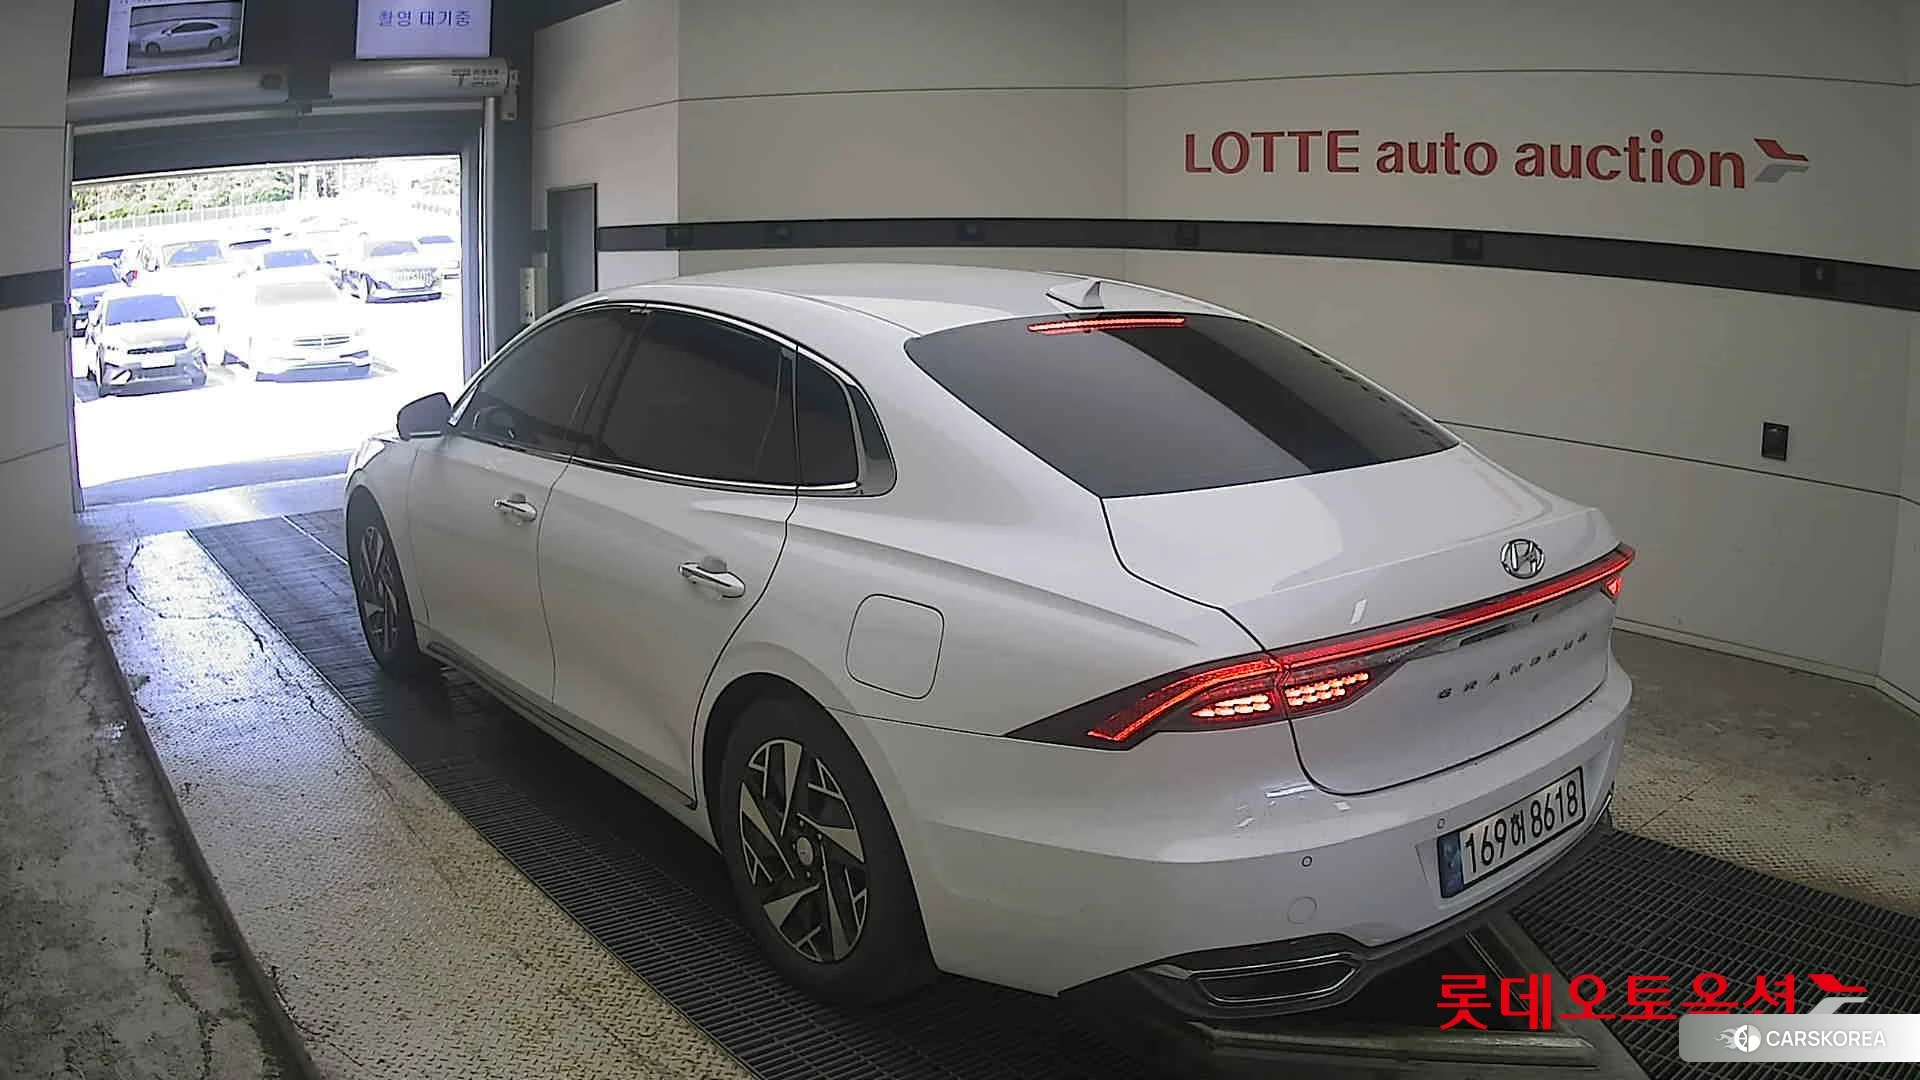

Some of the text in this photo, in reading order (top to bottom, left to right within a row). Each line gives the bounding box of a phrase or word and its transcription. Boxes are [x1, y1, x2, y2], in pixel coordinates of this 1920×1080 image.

[420, 10, 471, 27] 대기중
[1184, 129, 1746, 188] LOTTE auto auction
[1530, 780, 1578, 838] 8618
